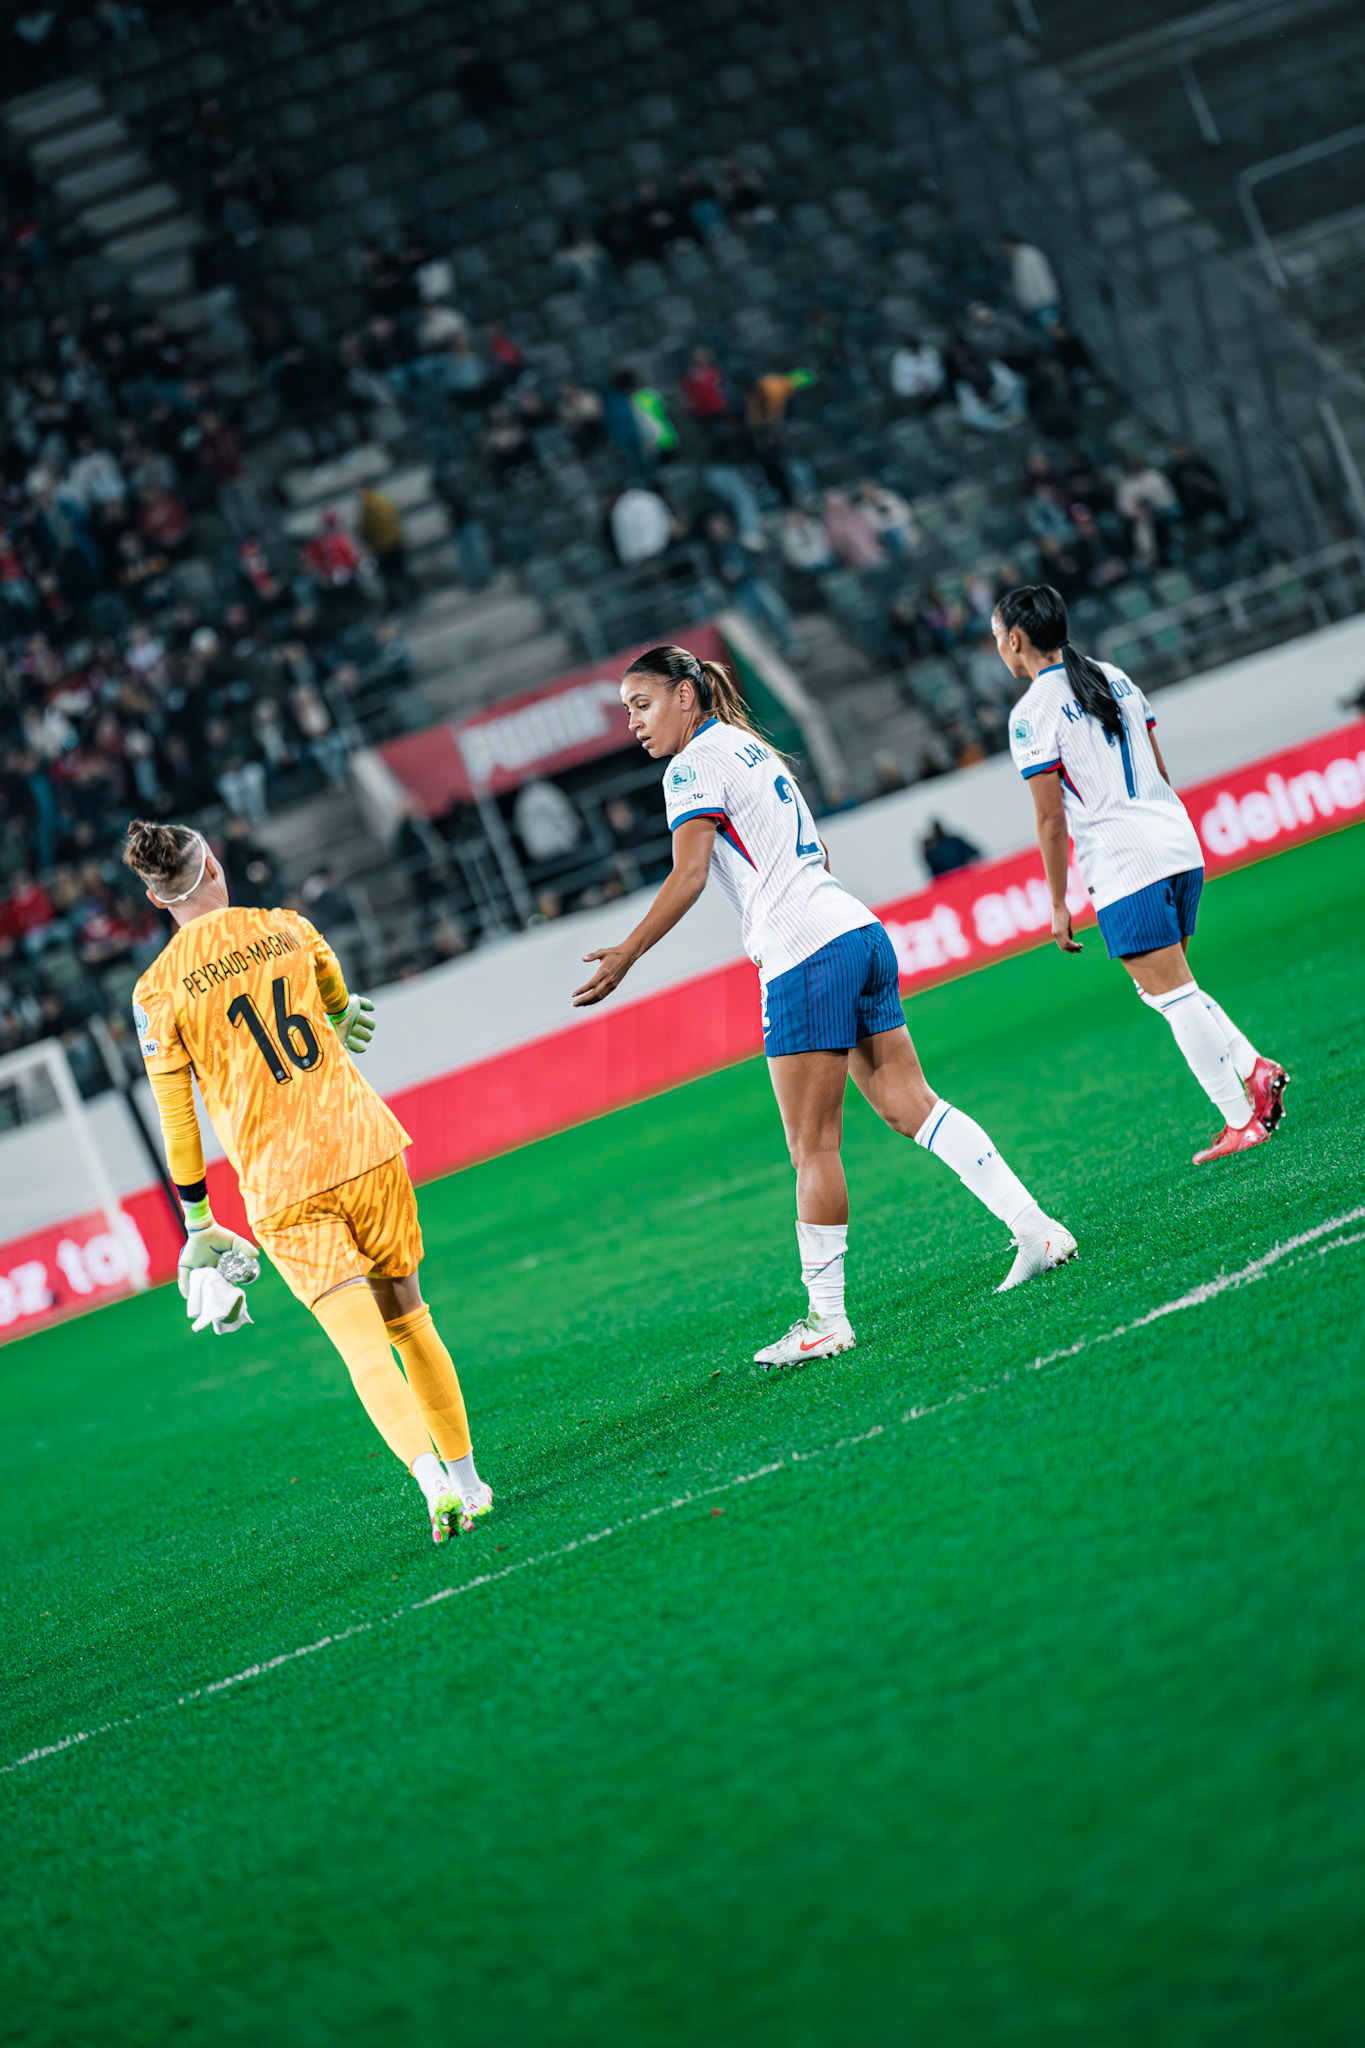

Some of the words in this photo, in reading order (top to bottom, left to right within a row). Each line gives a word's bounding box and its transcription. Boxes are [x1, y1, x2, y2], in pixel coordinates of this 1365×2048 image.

[774, 774, 824, 860] 2
[1201, 750, 1365, 857] deine
[182, 930, 302, 999] PEYRAUD-MAGNIN
[226, 975, 325, 1085] 16
